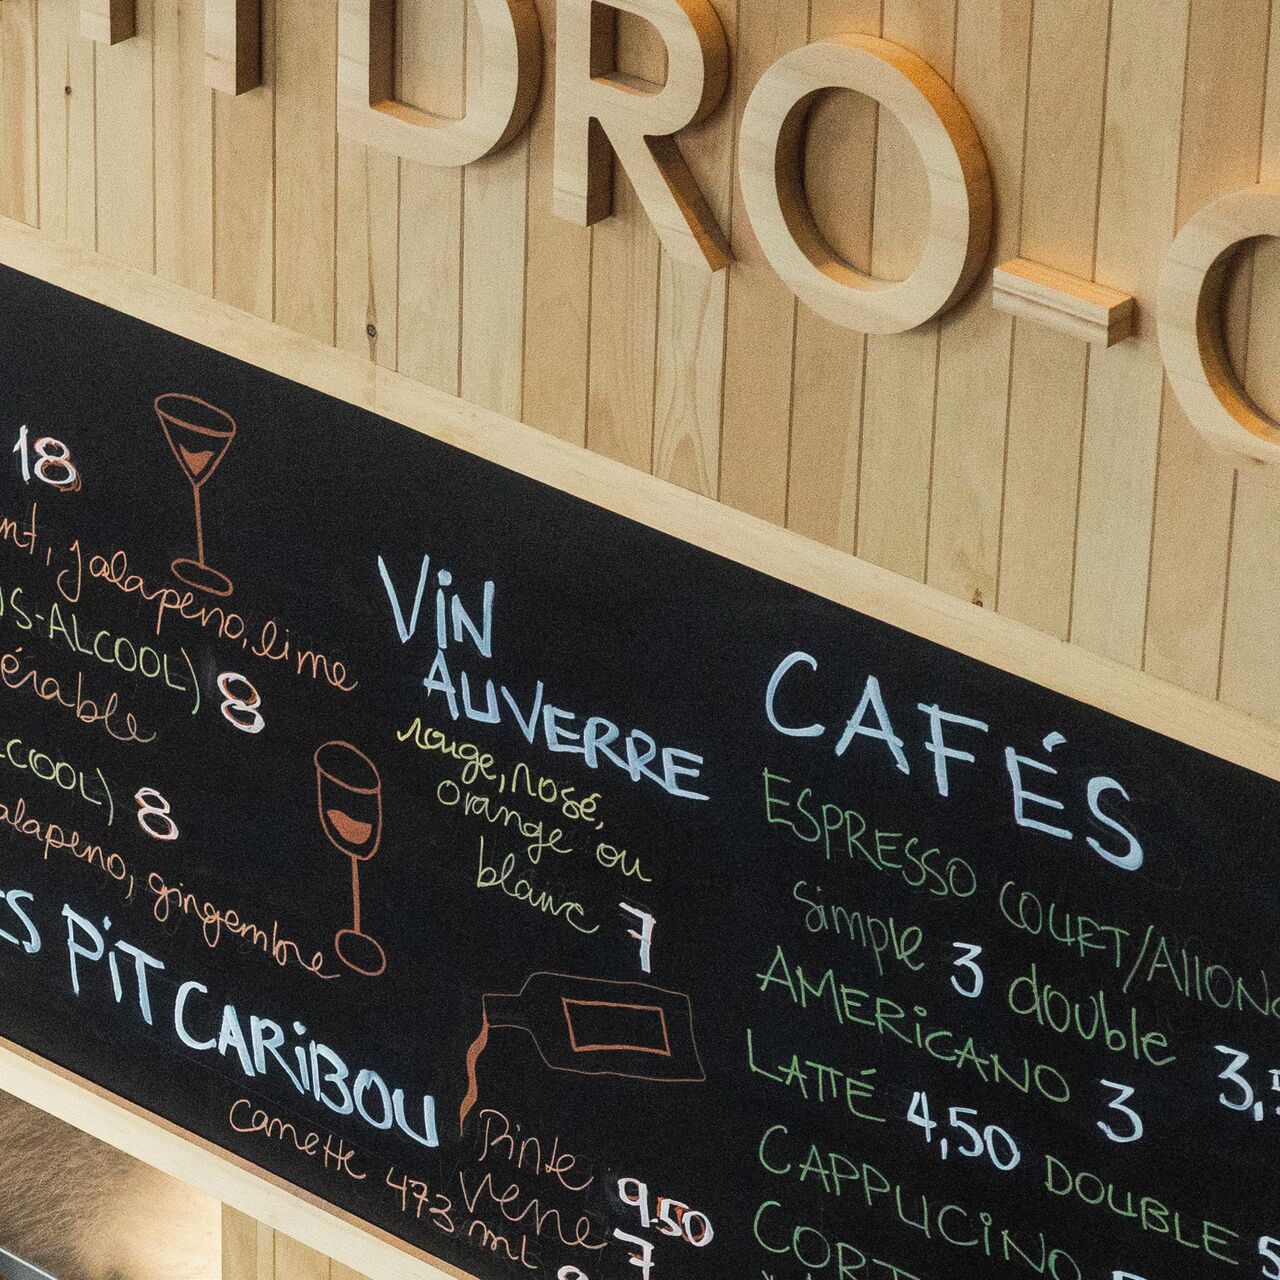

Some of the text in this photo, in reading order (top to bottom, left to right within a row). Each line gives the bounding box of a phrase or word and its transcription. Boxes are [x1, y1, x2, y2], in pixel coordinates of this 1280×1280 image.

[13, 424, 82, 492] 18
[217, 671, 265, 734] 8
[765, 650, 1144, 871] CAFÉS
[134, 787, 179, 840] 8
[762, 767, 977, 897] ESPRESSO
[596, 843, 653, 882] ou
[476, 835, 657, 974] blanc 7
[951, 942, 983, 997] 3
[1009, 963, 1177, 1066] double
[1097, 1079, 1143, 1143] 3
[747, 1028, 886, 1122] LATTÉ
[907, 1092, 1020, 1170] 4,50
[1045, 1155, 1239, 1265] DOUBLE
[385, 1166, 456, 1234] 473
